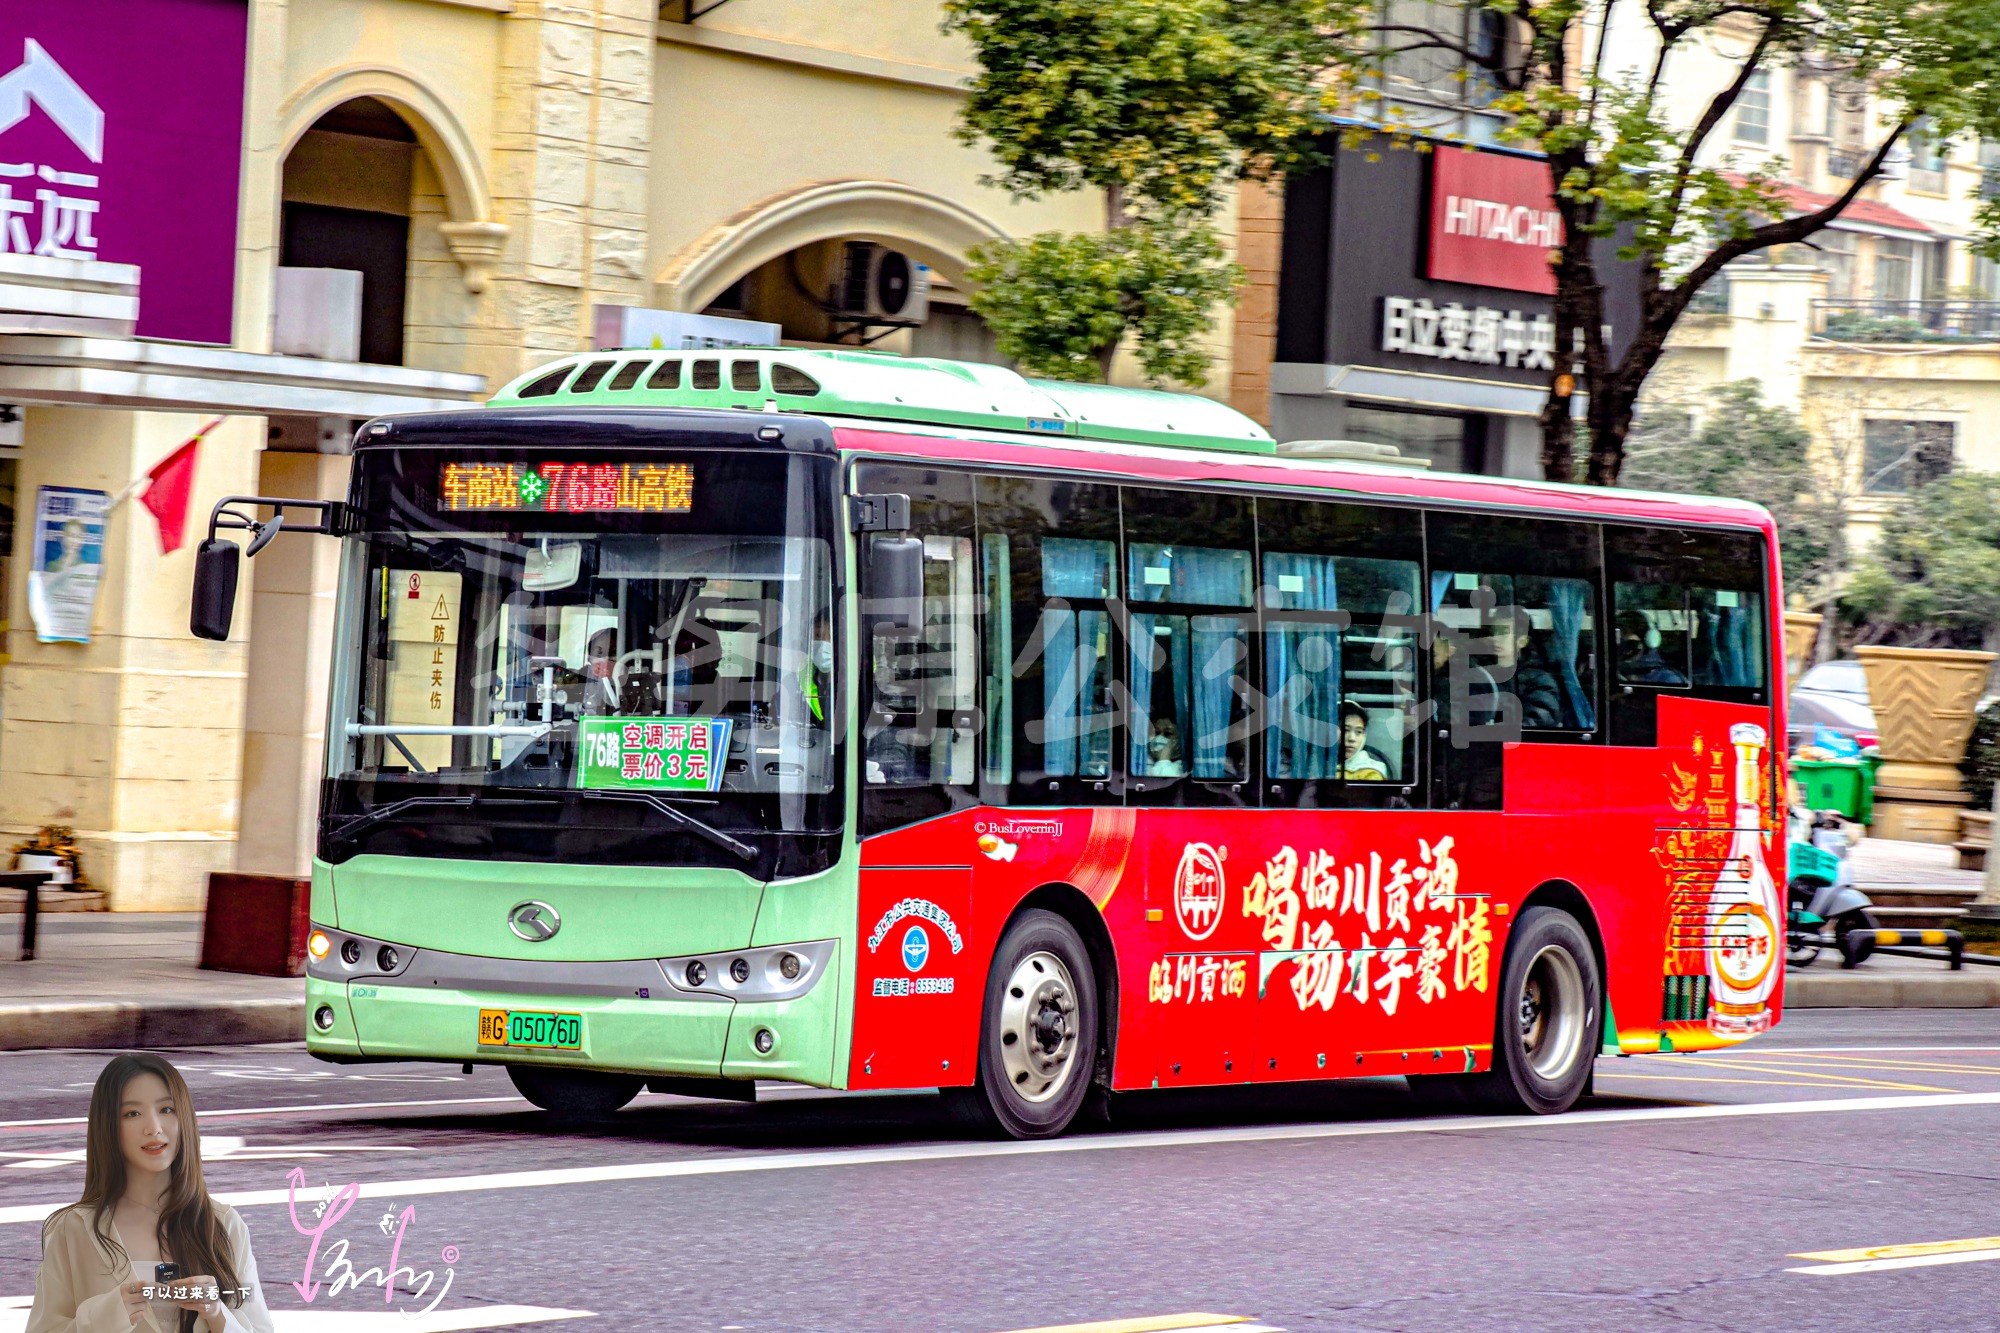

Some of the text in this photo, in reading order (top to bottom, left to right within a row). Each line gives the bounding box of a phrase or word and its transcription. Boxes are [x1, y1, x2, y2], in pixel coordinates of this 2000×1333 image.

[1444, 195, 1562, 248] HITACHI
[1383, 296, 1613, 371] 日立变频中央
[430, 624, 445, 710] 防止夹伤
[586, 732, 620, 768] 76路
[623, 723, 708, 750] 空调开启
[622, 752, 707, 780] 票价3元
[1243, 835, 1459, 951] 喝临川贡酒
[868, 898, 963, 954] 九江市公共交通集团公司
[1288, 897, 1493, 1016] 扬才子豪情
